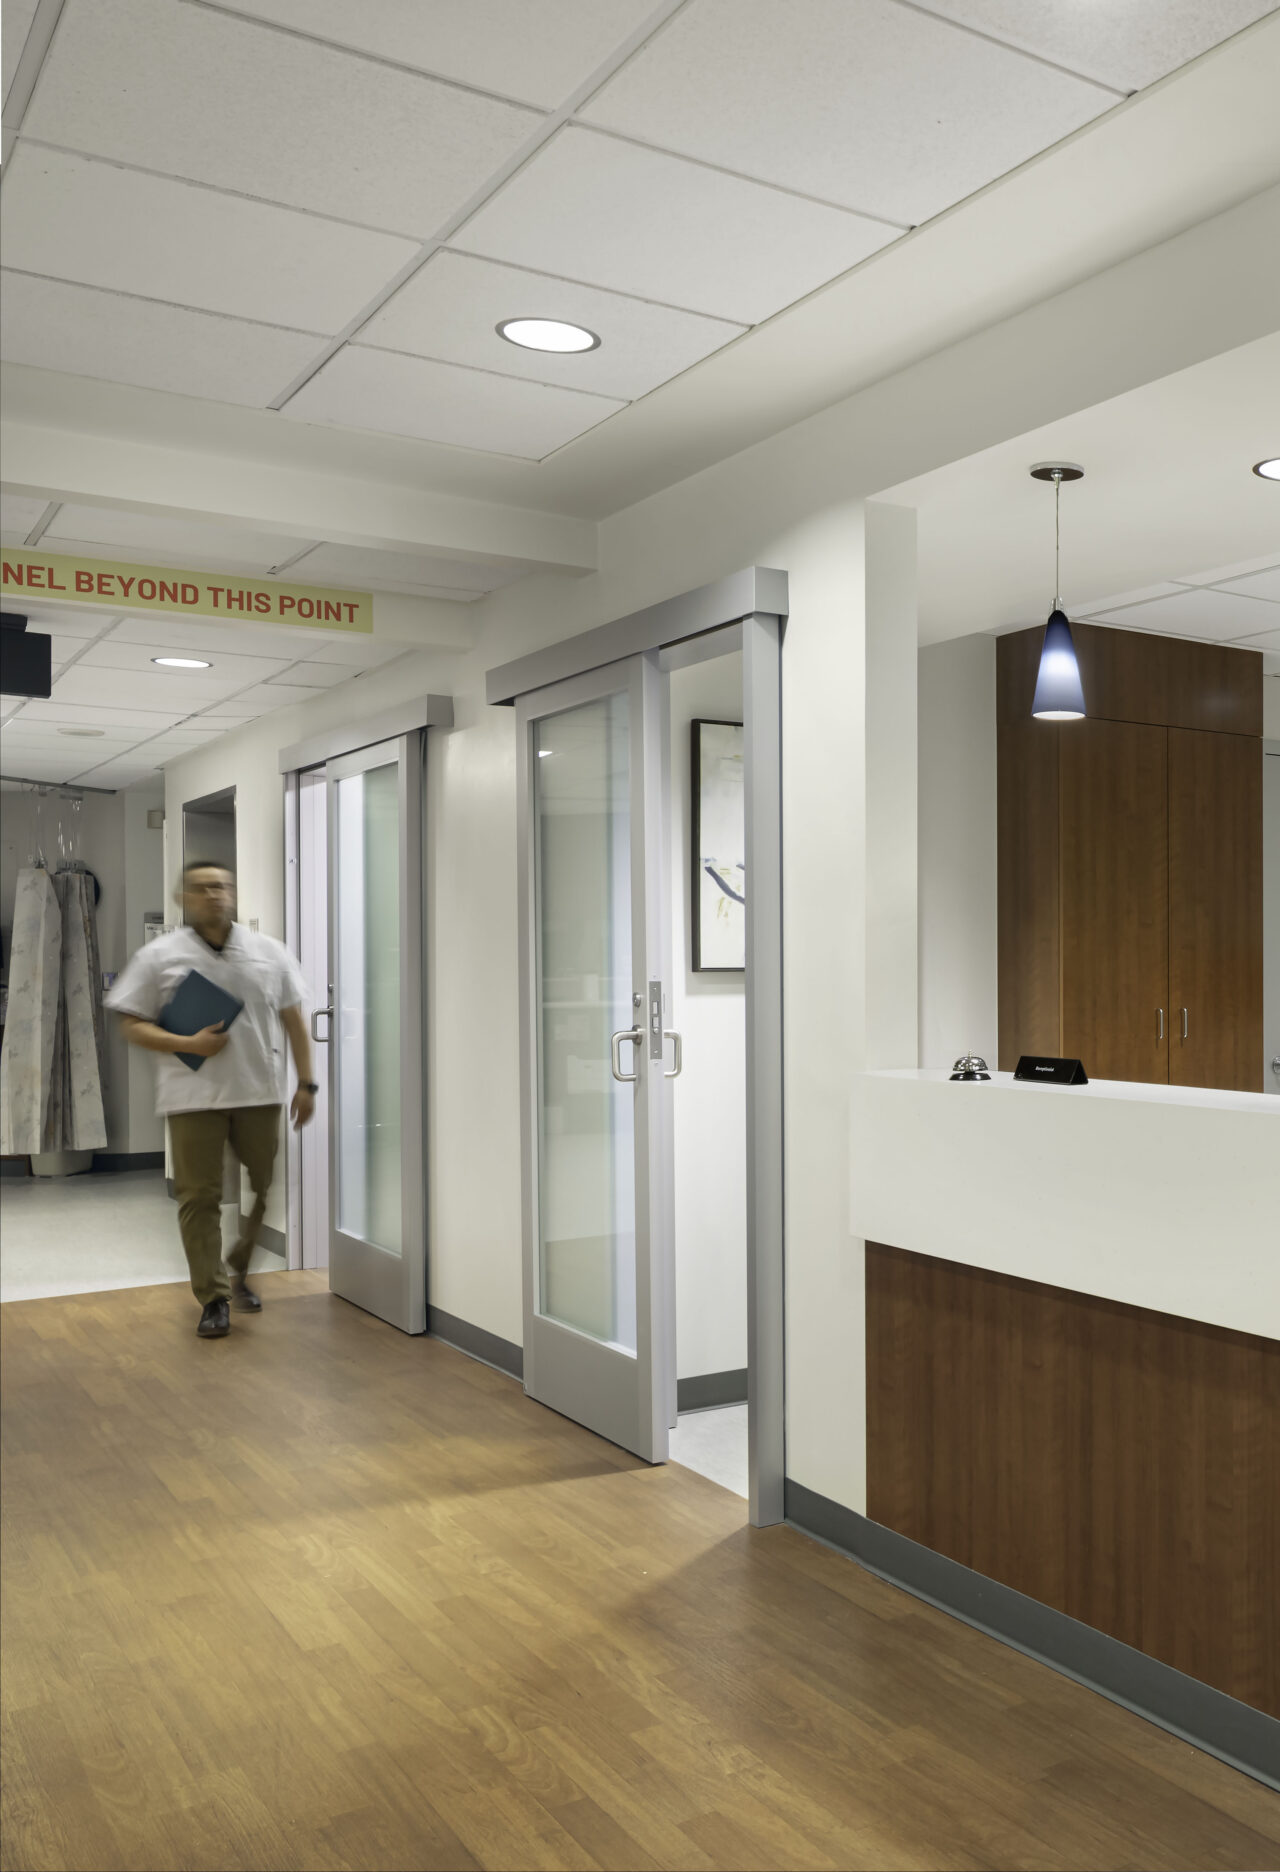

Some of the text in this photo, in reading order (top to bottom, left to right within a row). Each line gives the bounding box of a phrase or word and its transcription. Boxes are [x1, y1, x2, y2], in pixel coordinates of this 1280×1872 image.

[75, 570, 199, 605] BEYOND
[207, 586, 271, 614] THIS
[279, 595, 359, 623] POINT
